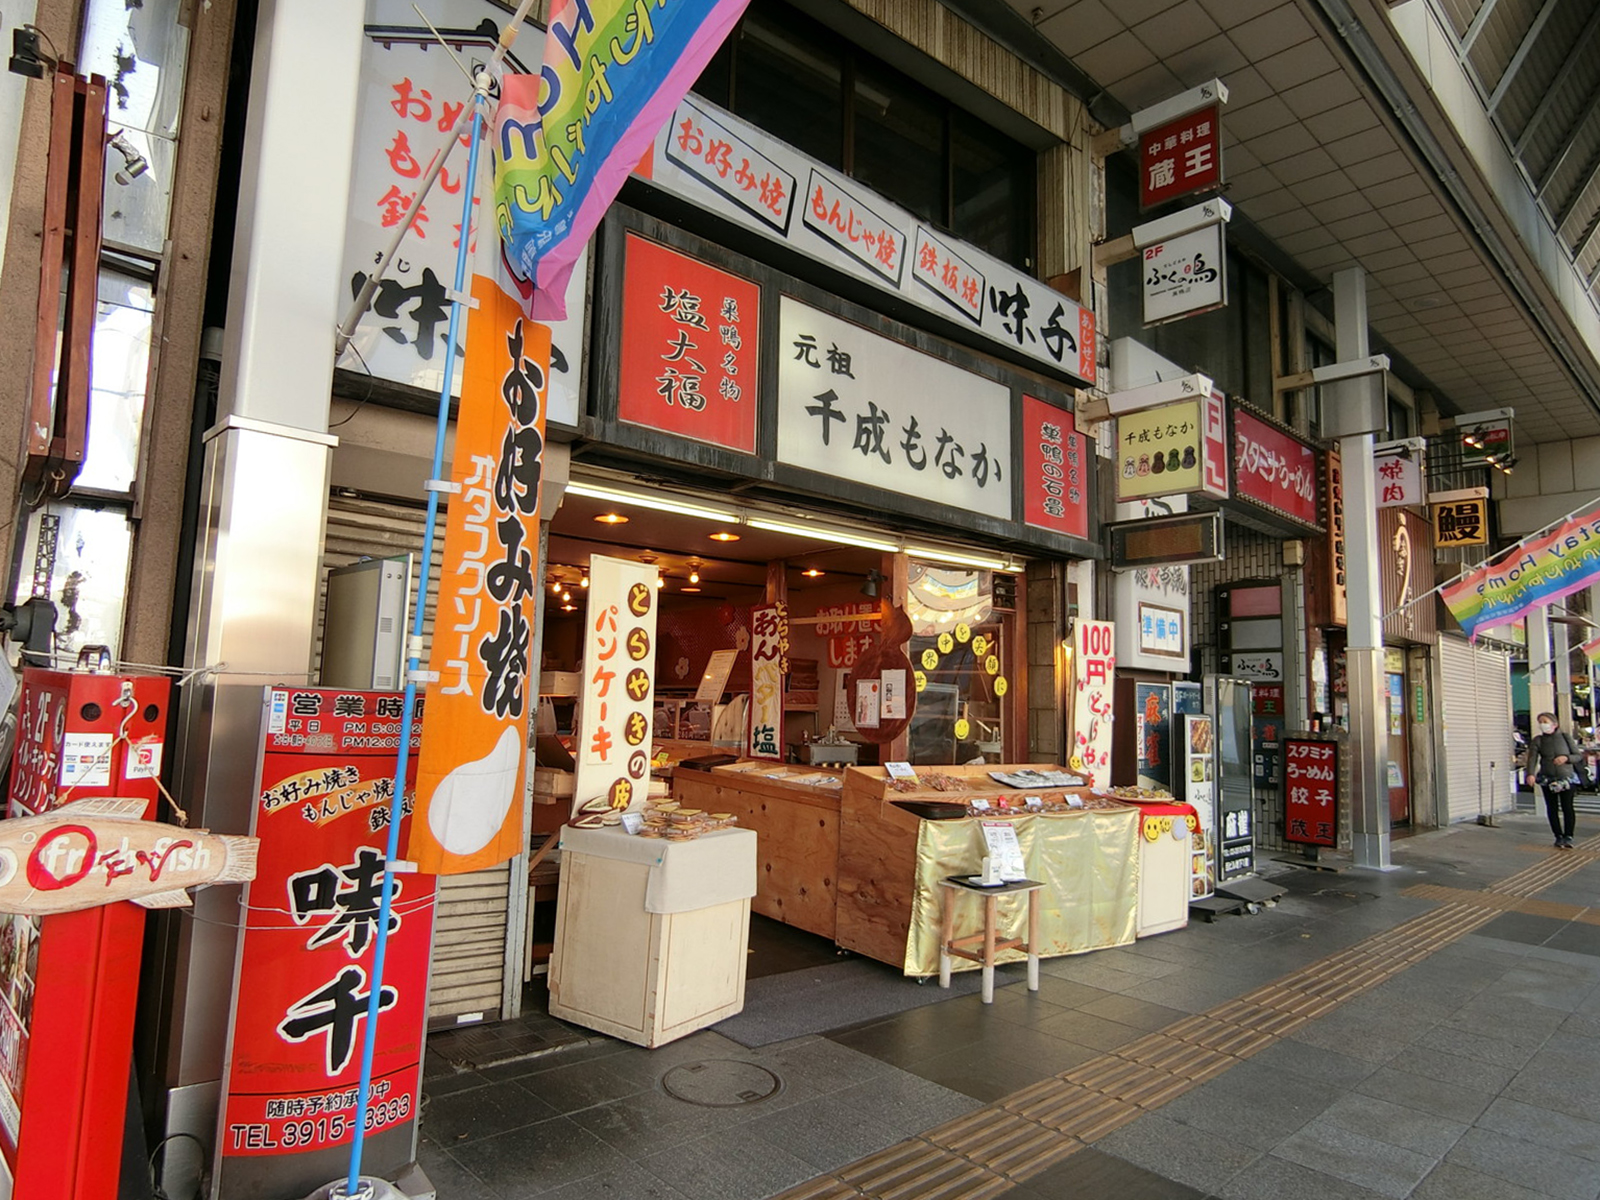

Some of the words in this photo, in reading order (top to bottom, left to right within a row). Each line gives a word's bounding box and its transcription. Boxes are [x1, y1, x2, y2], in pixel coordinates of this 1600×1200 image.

[1148, 121, 1211, 156] 中華料理
[677, 117, 786, 217] お好み焼
[1148, 143, 1213, 191] 蔵王
[811, 183, 897, 270] もんじゃ焼
[918, 241, 979, 310] 鉄板焼
[1145, 245, 1164, 260] 2F
[656, 285, 710, 412] 塩大福
[792, 333, 856, 380] 元祖
[1081, 313, 1094, 378] あじせん
[804, 388, 1003, 488] 千成もなか
[1124, 421, 1194, 446] 千成もなか
[1379, 459, 1405, 503] 焼肉
[1438, 502, 1482, 543] 鰻
[441, 453, 495, 697] オタフクソース
[775, 601, 790, 675] どらやき
[1143, 614, 1179, 641] 準備中
[591, 605, 618, 761] パンケーキ
[613, 585, 649, 809] どらやきの皮
[754, 611, 778, 755] あんバター塩
[34, 692, 51, 743] 2F
[288, 719, 321, 732] 平日
[344, 722, 366, 734] PM
[1287, 763, 1334, 781] らーめん
[1288, 745, 1333, 759] スタミナ
[262, 766, 360, 809] お好み焼き
[302, 777, 406, 823] もんじゃ焼
[1290, 786, 1334, 807] 餃子
[1290, 819, 1334, 840] 蔵王
[276, 846, 402, 1077] 味千
[231, 1123, 277, 1150] TEL
[282, 1093, 411, 1147] 3915-3333
